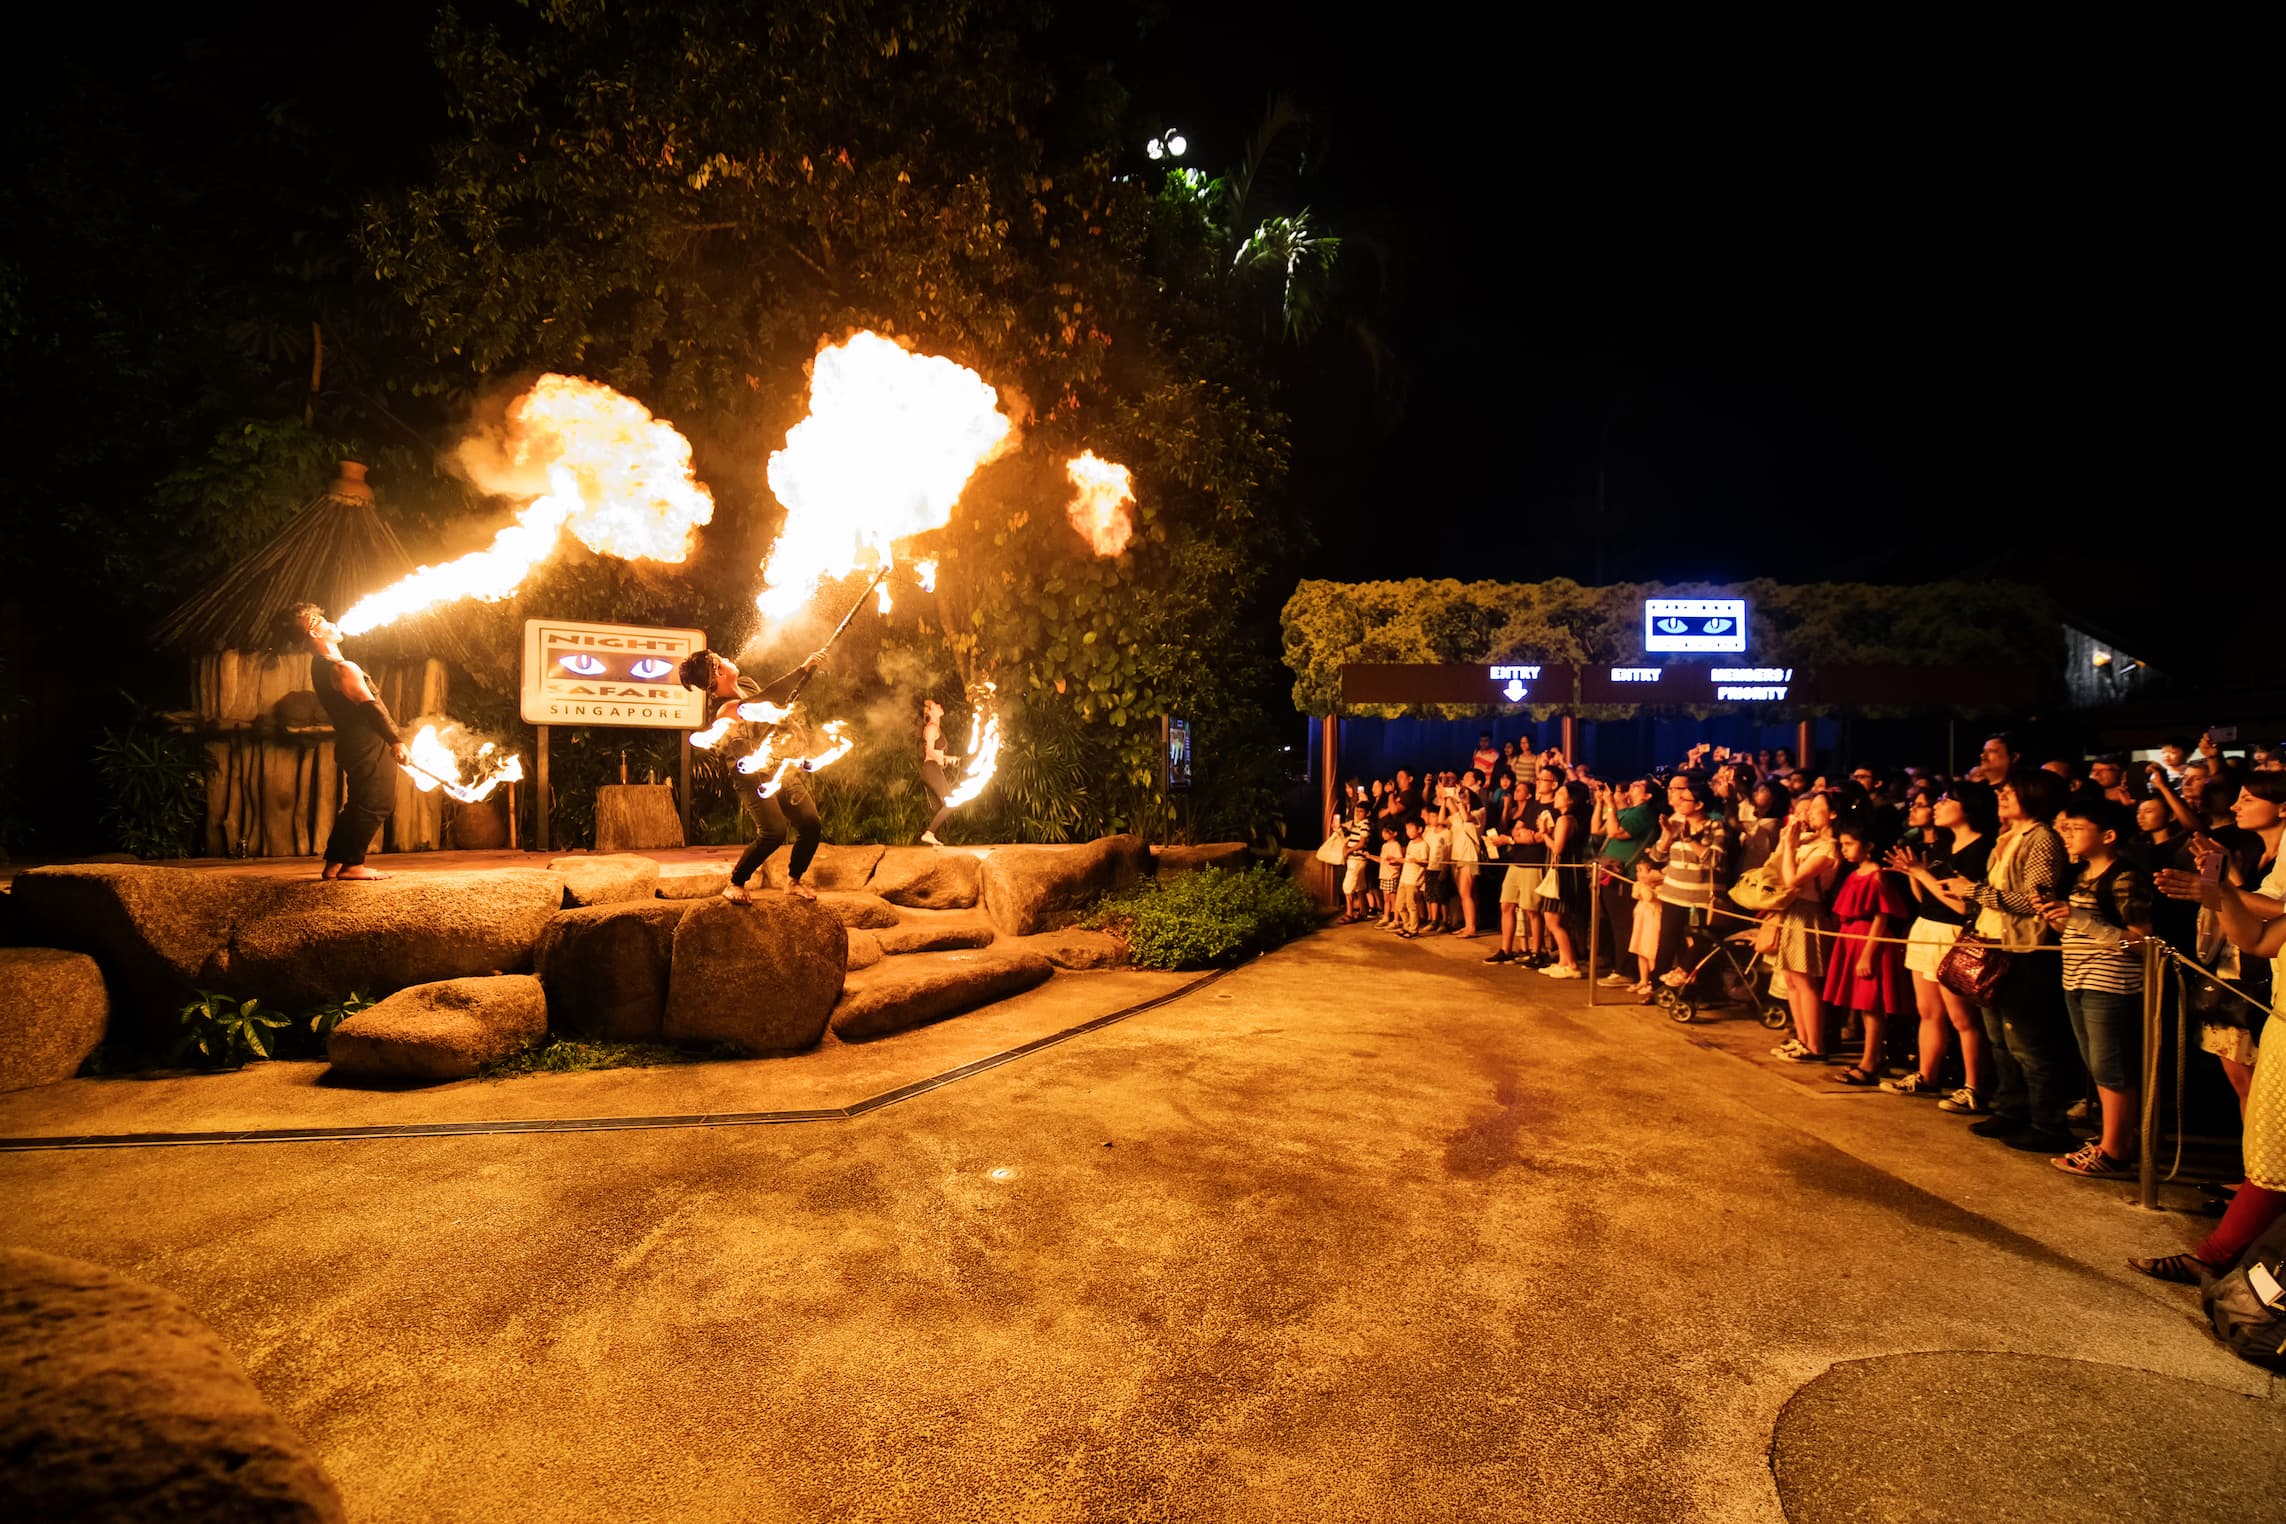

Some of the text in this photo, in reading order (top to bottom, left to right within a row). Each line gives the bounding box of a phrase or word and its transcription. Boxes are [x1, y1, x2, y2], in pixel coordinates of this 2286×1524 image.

[548, 634, 684, 651] NIGHT
[1490, 666, 1541, 679] ENTRY
[1611, 668, 1662, 681] ENTRY
[550, 704, 681, 718] SINGAPORE
